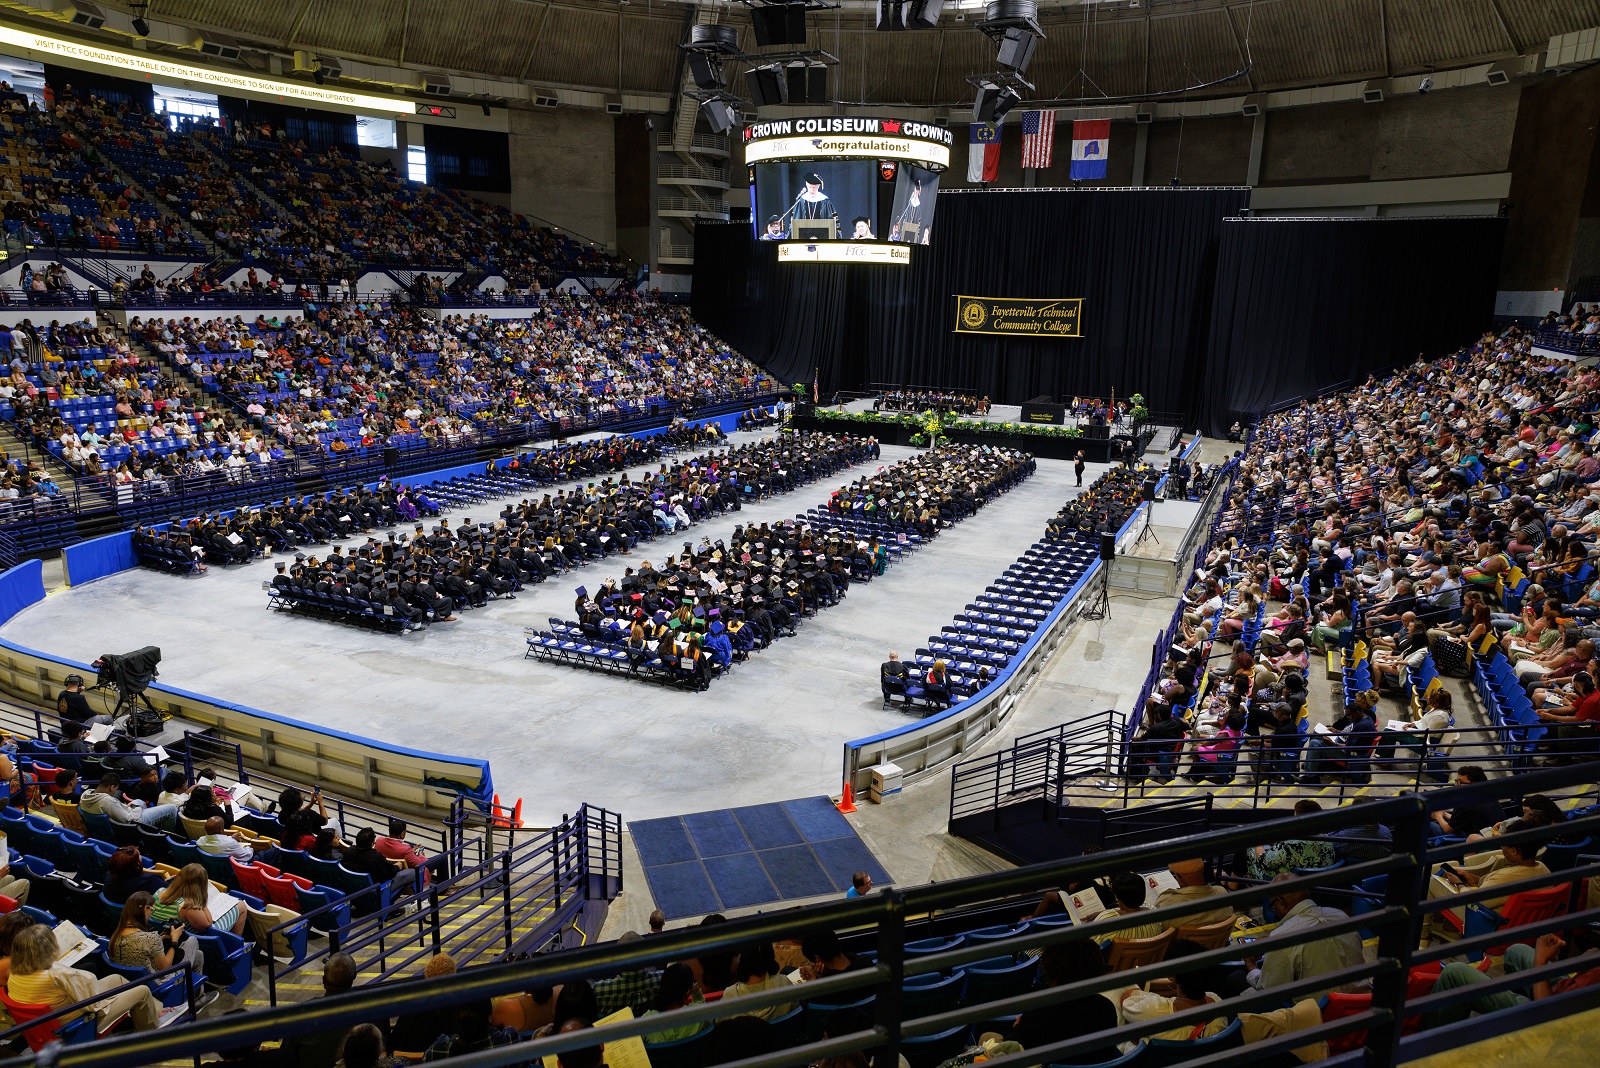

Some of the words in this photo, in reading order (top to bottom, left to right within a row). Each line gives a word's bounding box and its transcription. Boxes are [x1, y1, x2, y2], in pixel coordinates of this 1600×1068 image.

[35, 39, 55, 50] VISIT
[56, 43, 78, 54] FTCC
[78, 48, 135, 66] FOUNDATION'S
[136, 60, 159, 71] TABLE
[160, 64, 176, 74] OUT
[177, 68, 188, 76] ON
[189, 69, 203, 78] THE
[204, 72, 247, 87] CONCOURSE
[248, 80, 258, 88] TO
[258, 82, 275, 92] SIGN
[275, 85, 285, 93] UP
[285, 86, 299, 95] FOR
[300, 89, 325, 99] ALUMNI
[752, 119, 791, 138] CROWN
[796, 118, 879, 133] COLISEUM
[903, 121, 944, 141] CROWN
[816, 138, 910, 153] Congratulations!
[126, 265, 137, 273] 217
[991, 305, 1036, 319] Fayetteville
[1038, 301, 1077, 318] Technical
[993, 318, 1042, 334] Community
[1043, 320, 1072, 335] College
